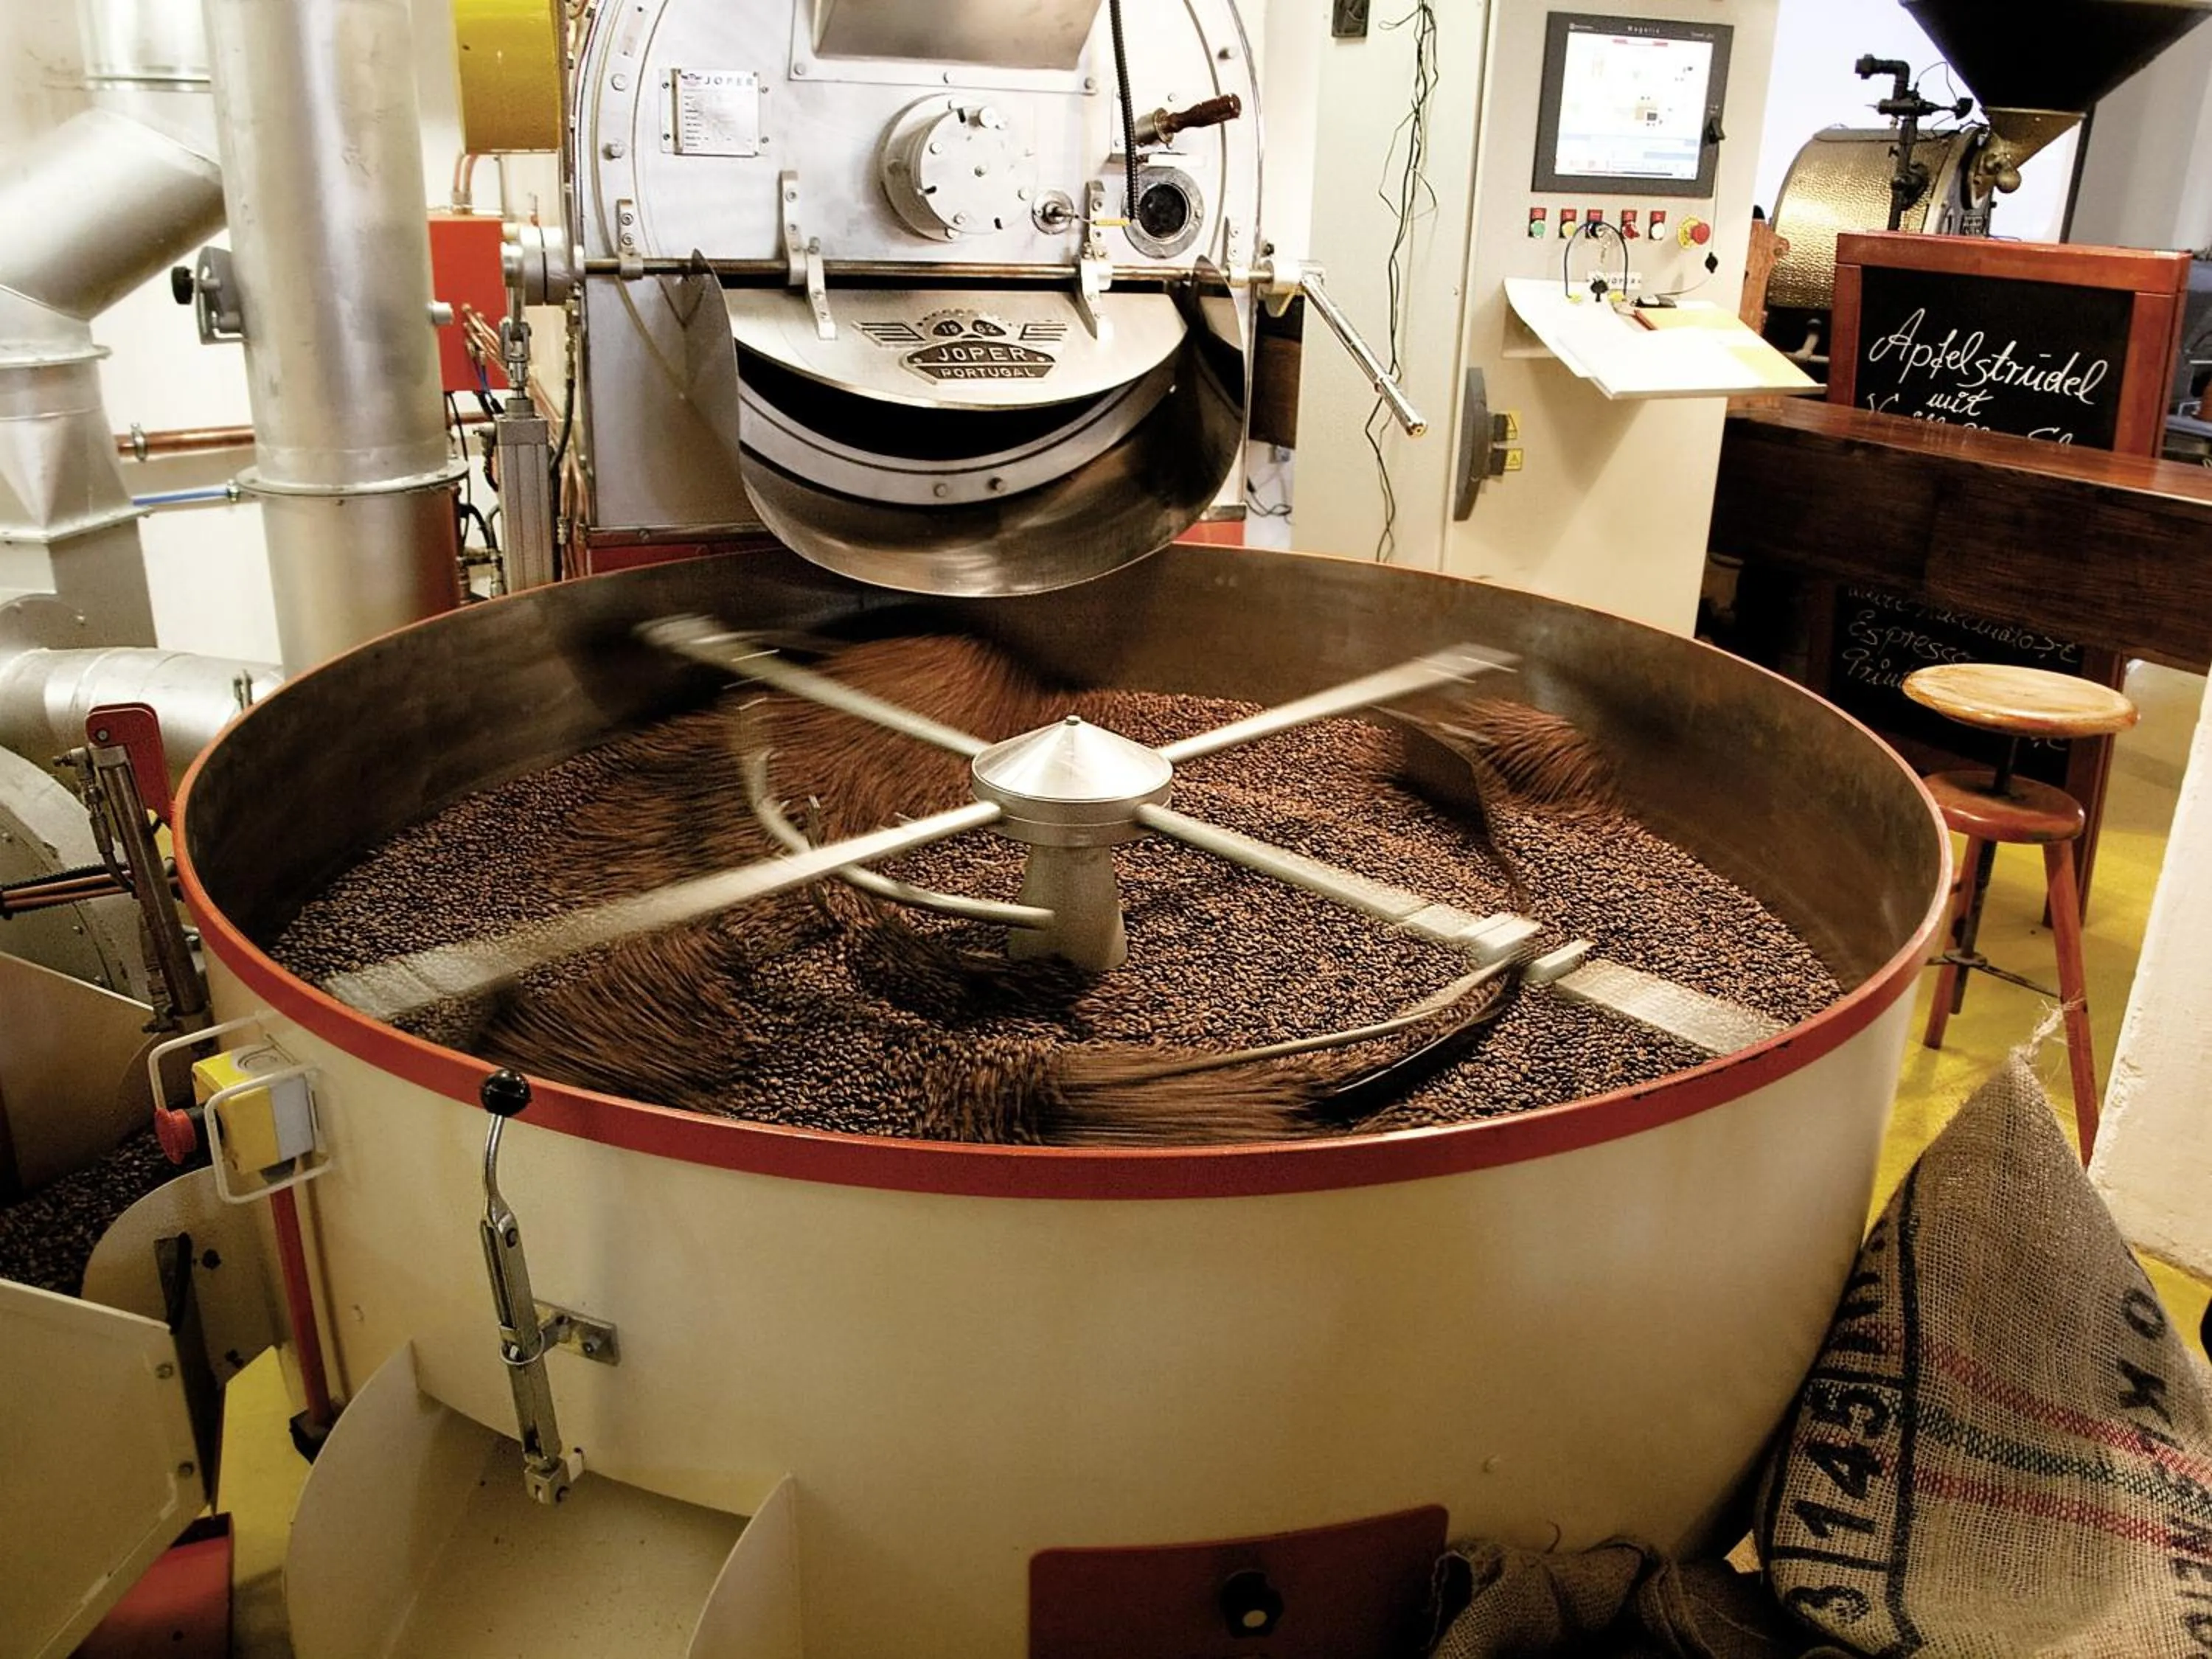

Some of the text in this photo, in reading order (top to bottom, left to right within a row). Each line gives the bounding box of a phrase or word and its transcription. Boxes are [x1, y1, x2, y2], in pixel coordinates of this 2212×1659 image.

[937, 347, 1028, 361] JOPER
[940, 367, 1035, 378] PORTUGAL
[1926, 389, 1994, 416] mit
